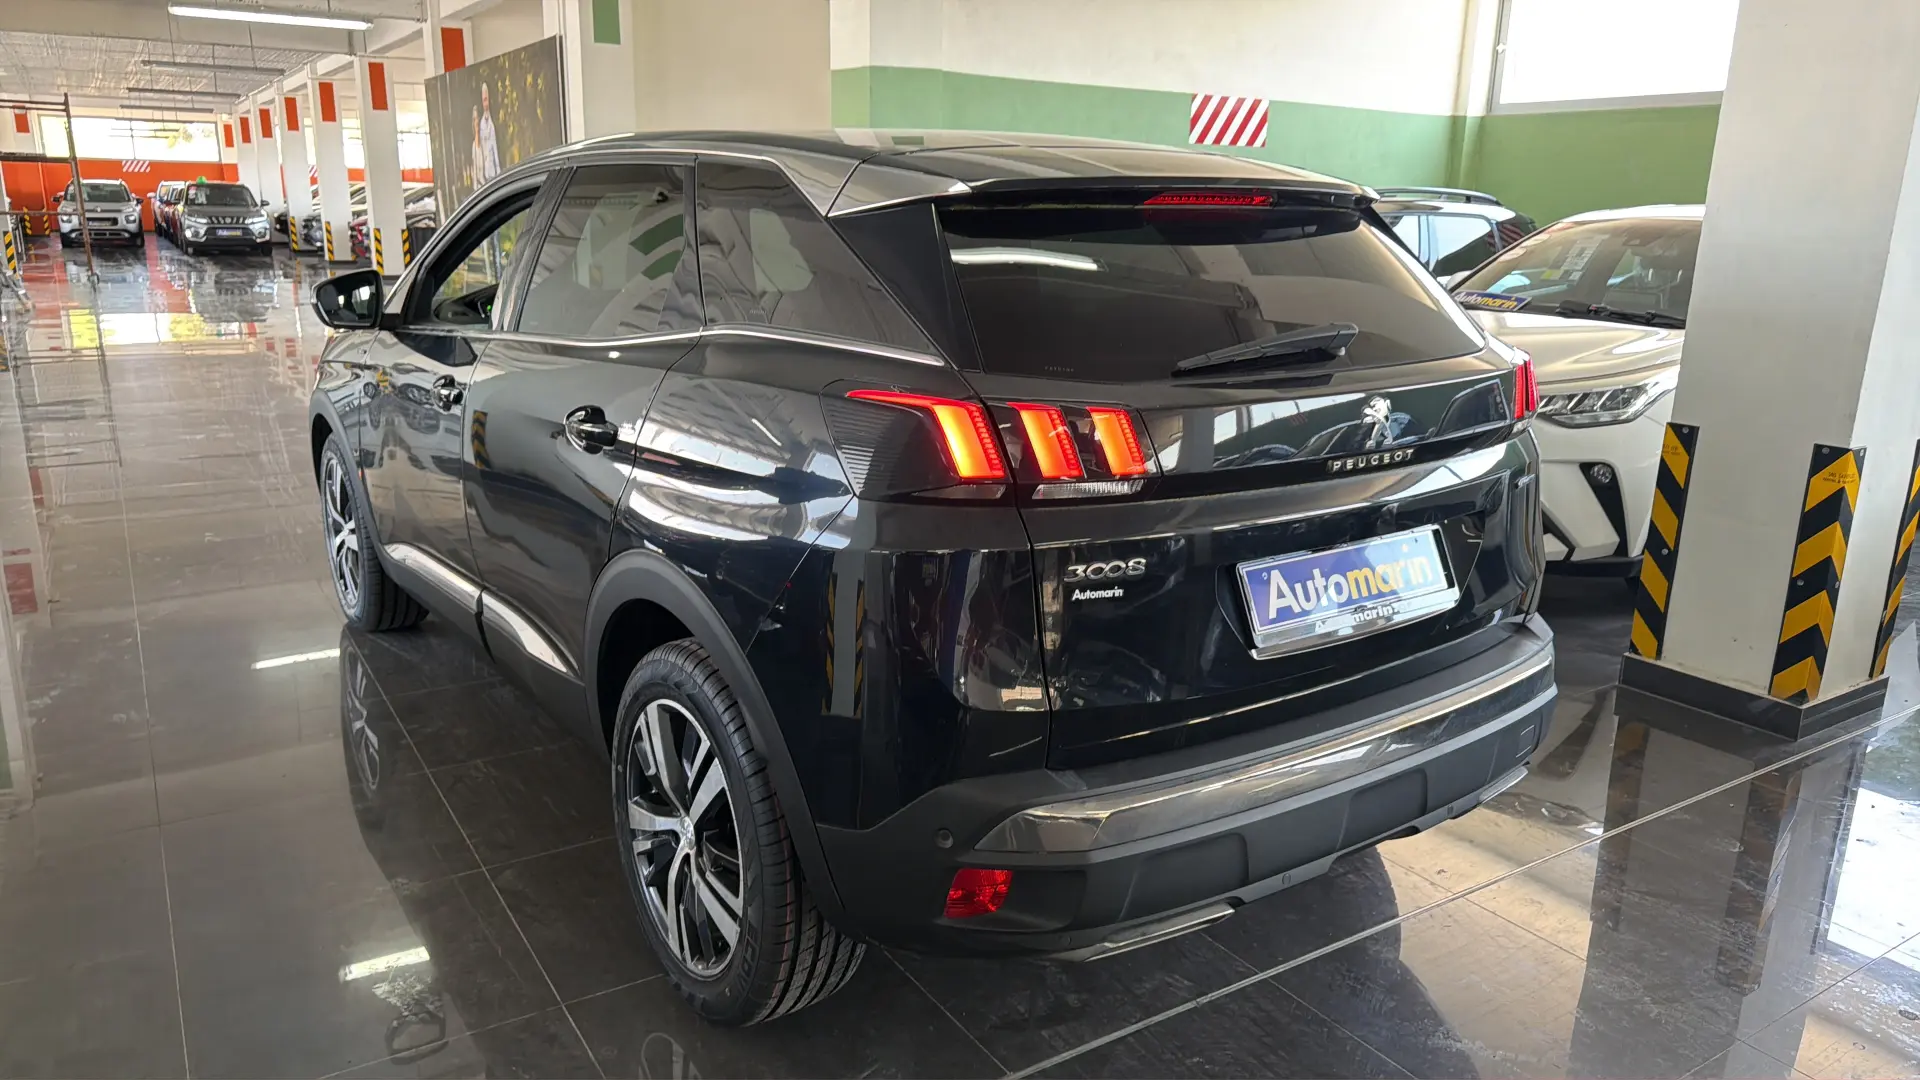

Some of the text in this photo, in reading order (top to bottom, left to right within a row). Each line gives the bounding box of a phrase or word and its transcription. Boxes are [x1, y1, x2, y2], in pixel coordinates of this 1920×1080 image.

[1454, 291, 1518, 309] Automarin
[1332, 449, 1414, 471] PEUGEOT
[1063, 557, 1147, 582] 3008
[1268, 543, 1434, 620] Automarin
[1072, 586, 1124, 601] Automarin
